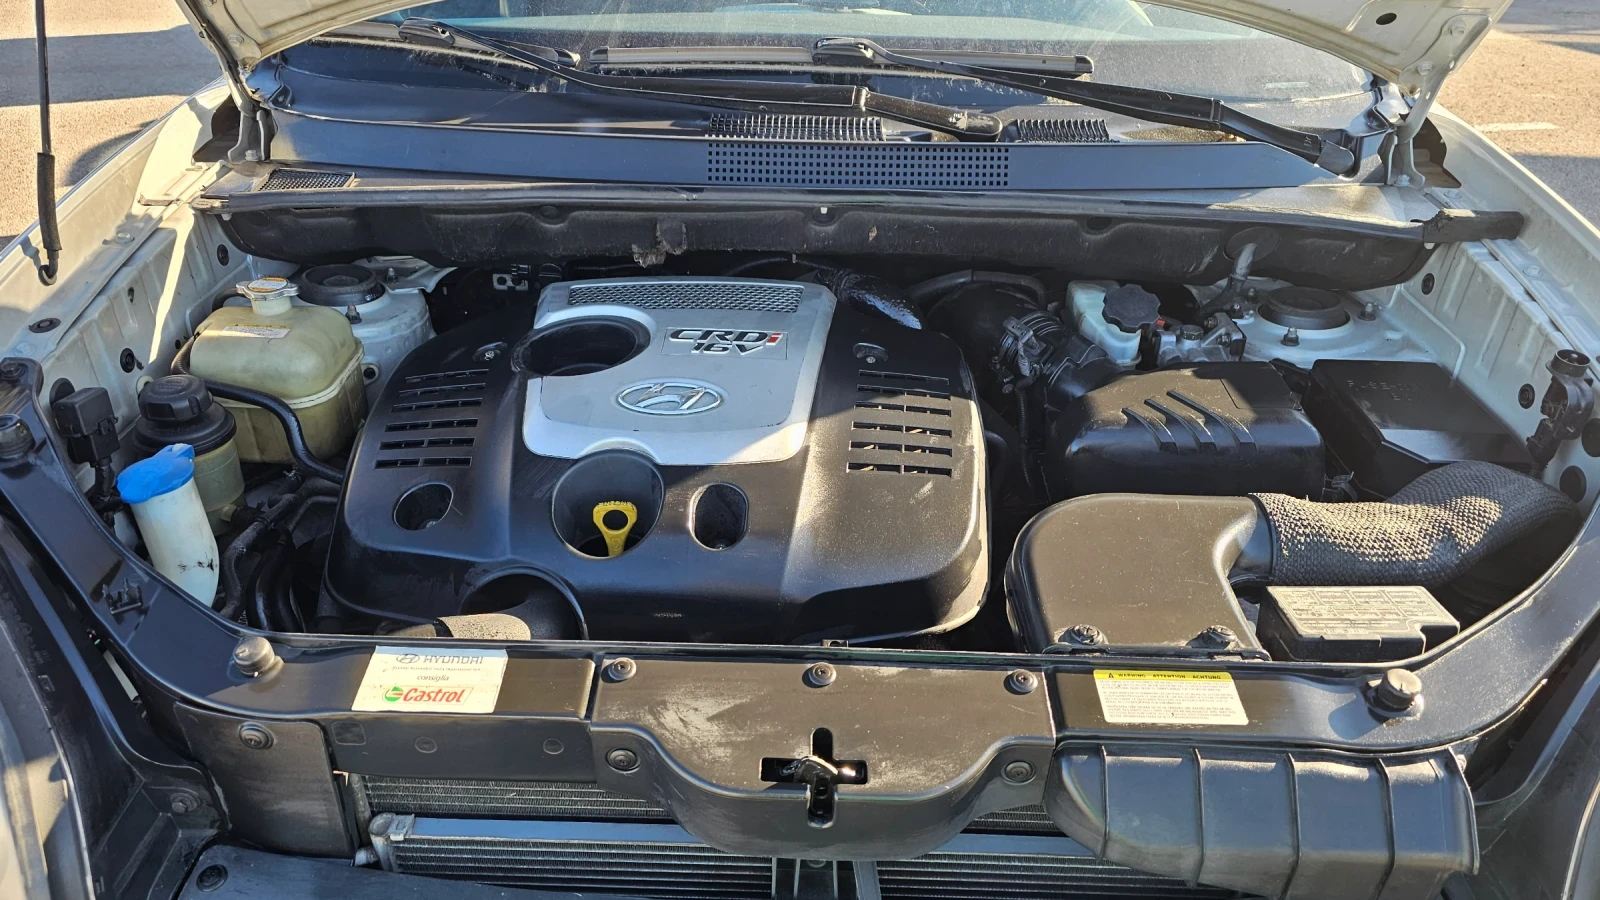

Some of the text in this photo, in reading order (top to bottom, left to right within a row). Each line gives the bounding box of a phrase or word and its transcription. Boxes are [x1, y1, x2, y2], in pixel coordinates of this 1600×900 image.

[691, 342, 764, 355] 16V
[423, 655, 484, 664] HYUNDAI
[403, 688, 466, 703] Castrol
